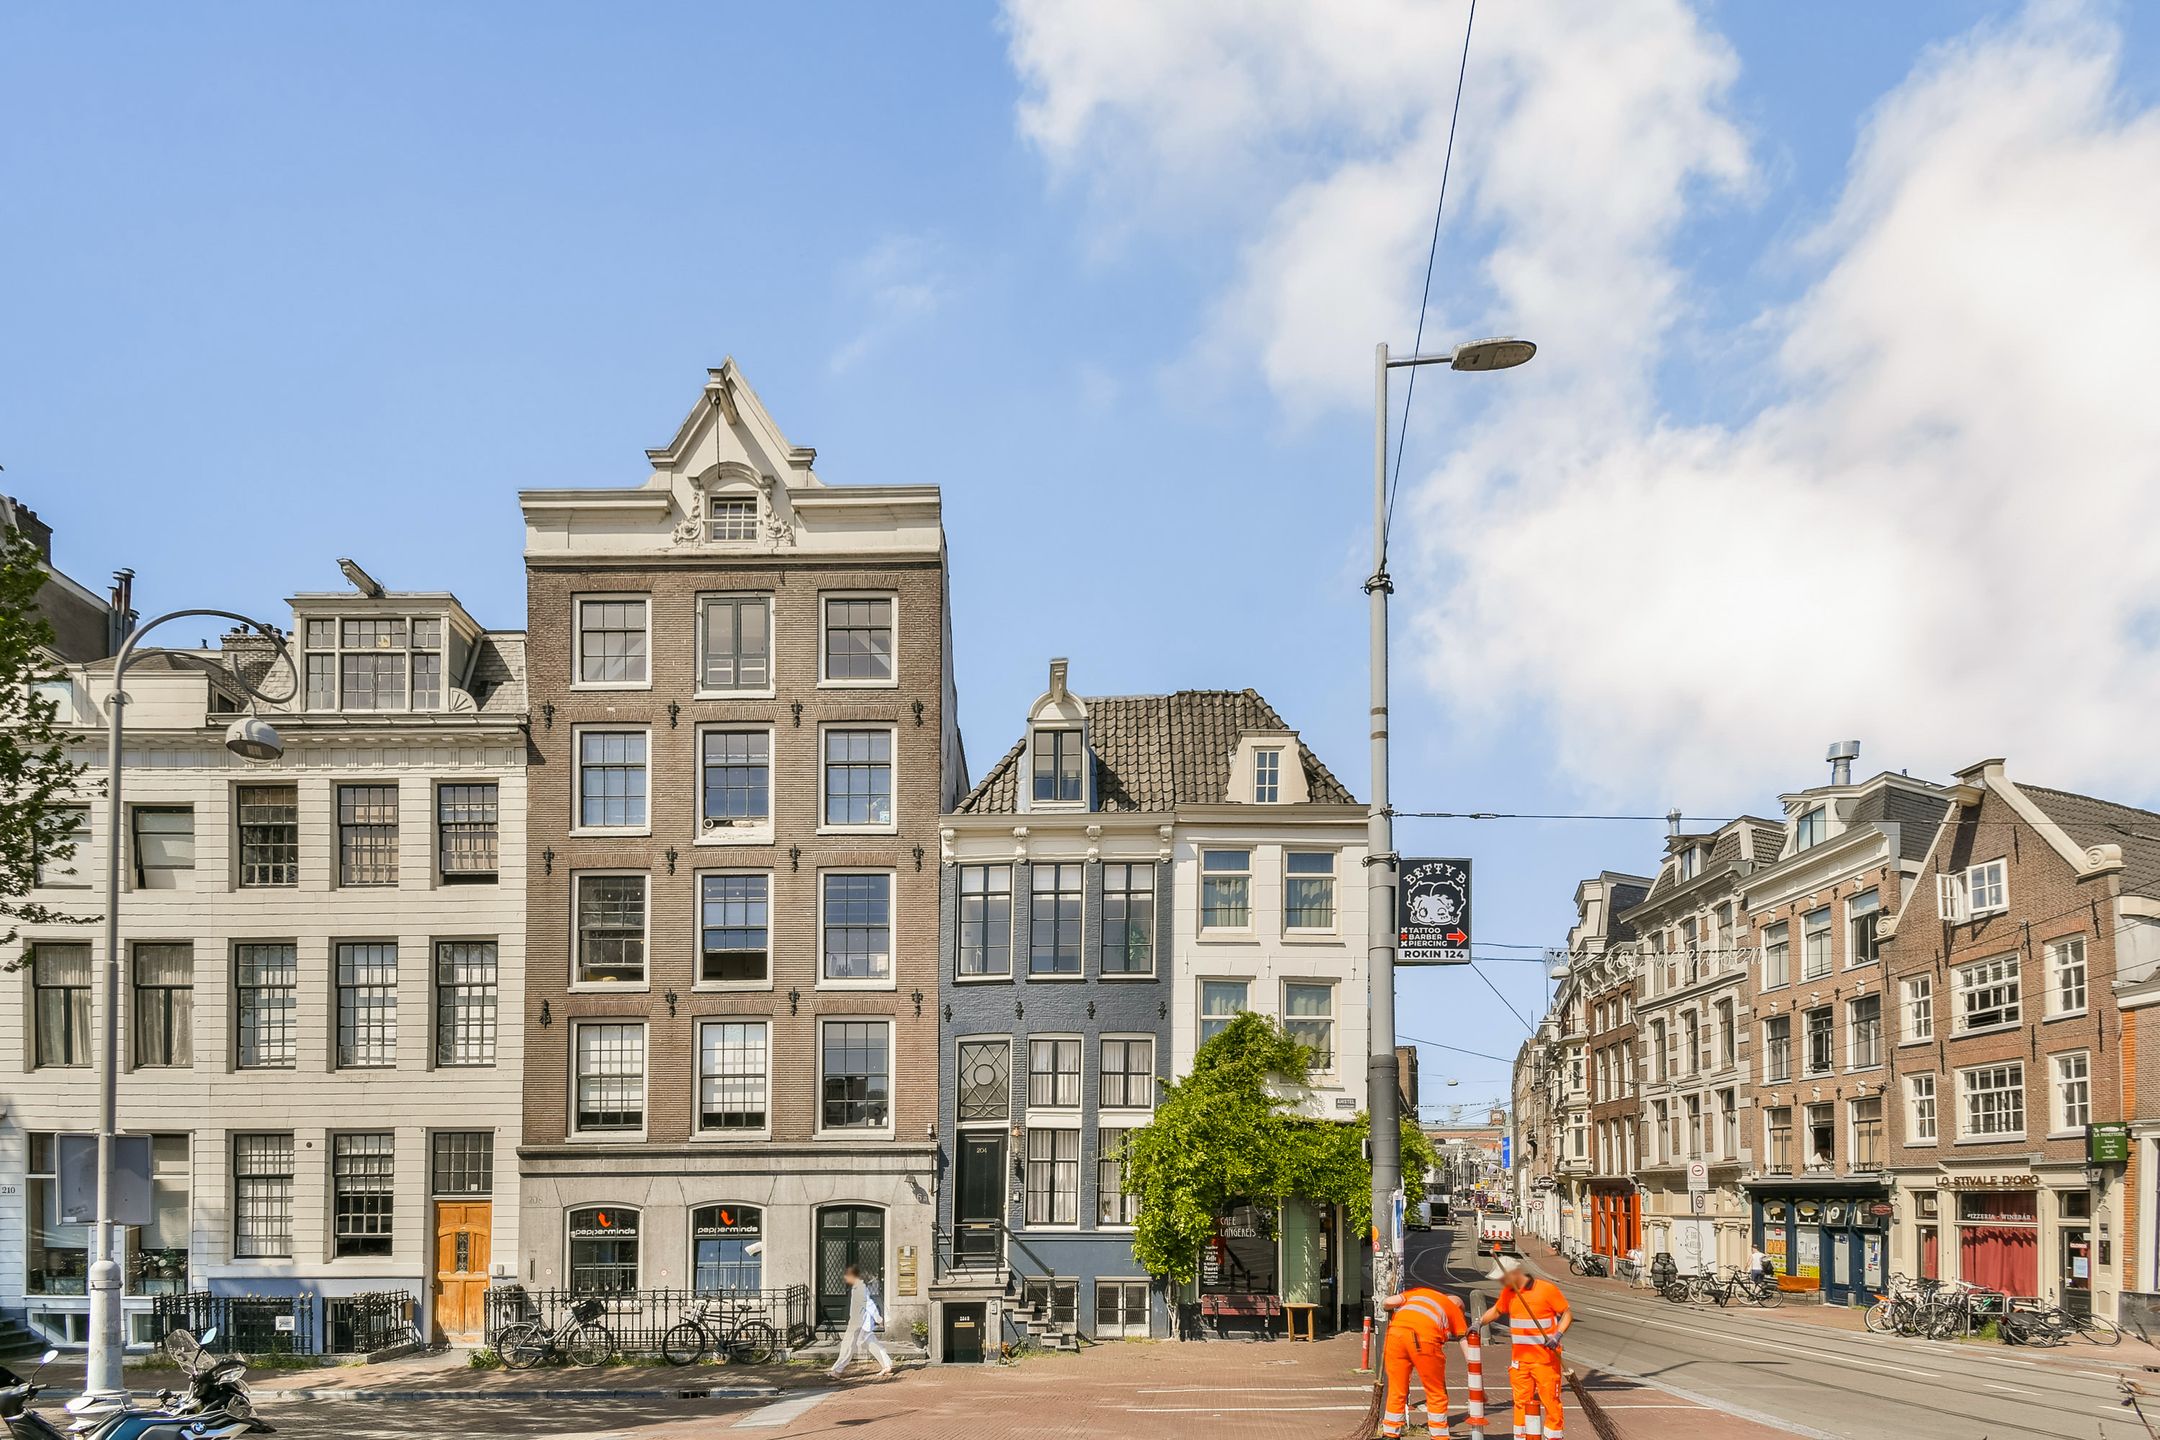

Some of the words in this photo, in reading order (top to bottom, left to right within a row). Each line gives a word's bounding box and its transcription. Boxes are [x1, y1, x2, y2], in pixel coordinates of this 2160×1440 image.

[1403, 863, 1457, 885] BETTY
[1456, 871, 1467, 888] B.
[1404, 950, 1442, 959] ROKIN
[1444, 950, 1465, 959] 124
[1953, 1175, 1998, 1186] STIVALE
[2002, 1174, 2040, 1185] D'ORO
[1, 1186, 16, 1194] 210
[575, 1228, 636, 1237] pepperminds
[697, 1225, 759, 1234] pepperminds
[1220, 1227, 1257, 1237] LANGEREIS
